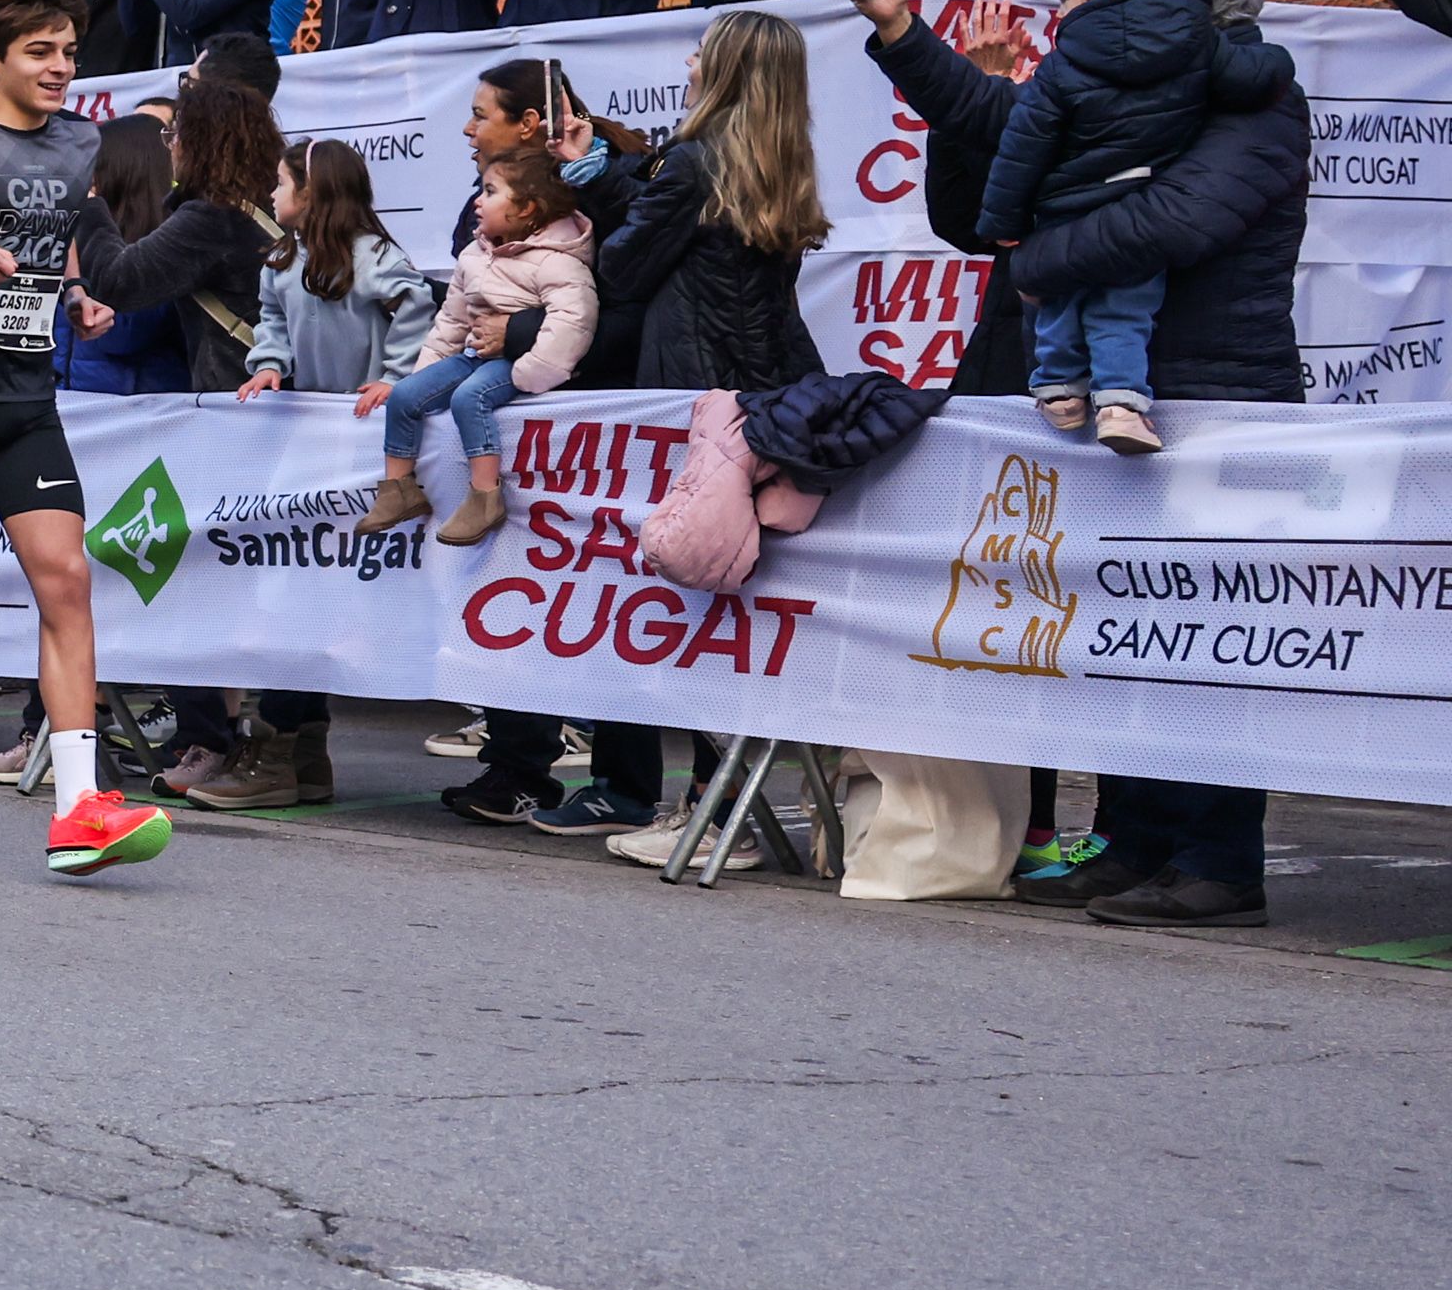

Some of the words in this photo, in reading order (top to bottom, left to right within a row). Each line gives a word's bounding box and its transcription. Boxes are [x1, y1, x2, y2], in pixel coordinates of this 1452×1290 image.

[606, 84, 689, 116] AJUNT
[352, 132, 424, 161] NYENC
[1311, 113, 1342, 140] UB
[7, 177, 69, 209] CAP
[1310, 155, 1340, 183] NT
[1346, 155, 1420, 185] CUGAT
[853, 260, 994, 323] MIT
[1, 315, 30, 330] 3203
[859, 330, 965, 390] SA
[511, 419, 690, 504] MIT
[205, 487, 379, 522] AJUNTAMENT
[207, 522, 426, 582] SantCugat
[526, 500, 656, 577] SA
[1096, 559, 1199, 601] CLUB
[1212, 560, 1452, 611] MUNTANYE
[462, 577, 817, 677] CUGAT
[1088, 617, 1204, 663] SANT
[1213, 625, 1364, 672] CUGAT
